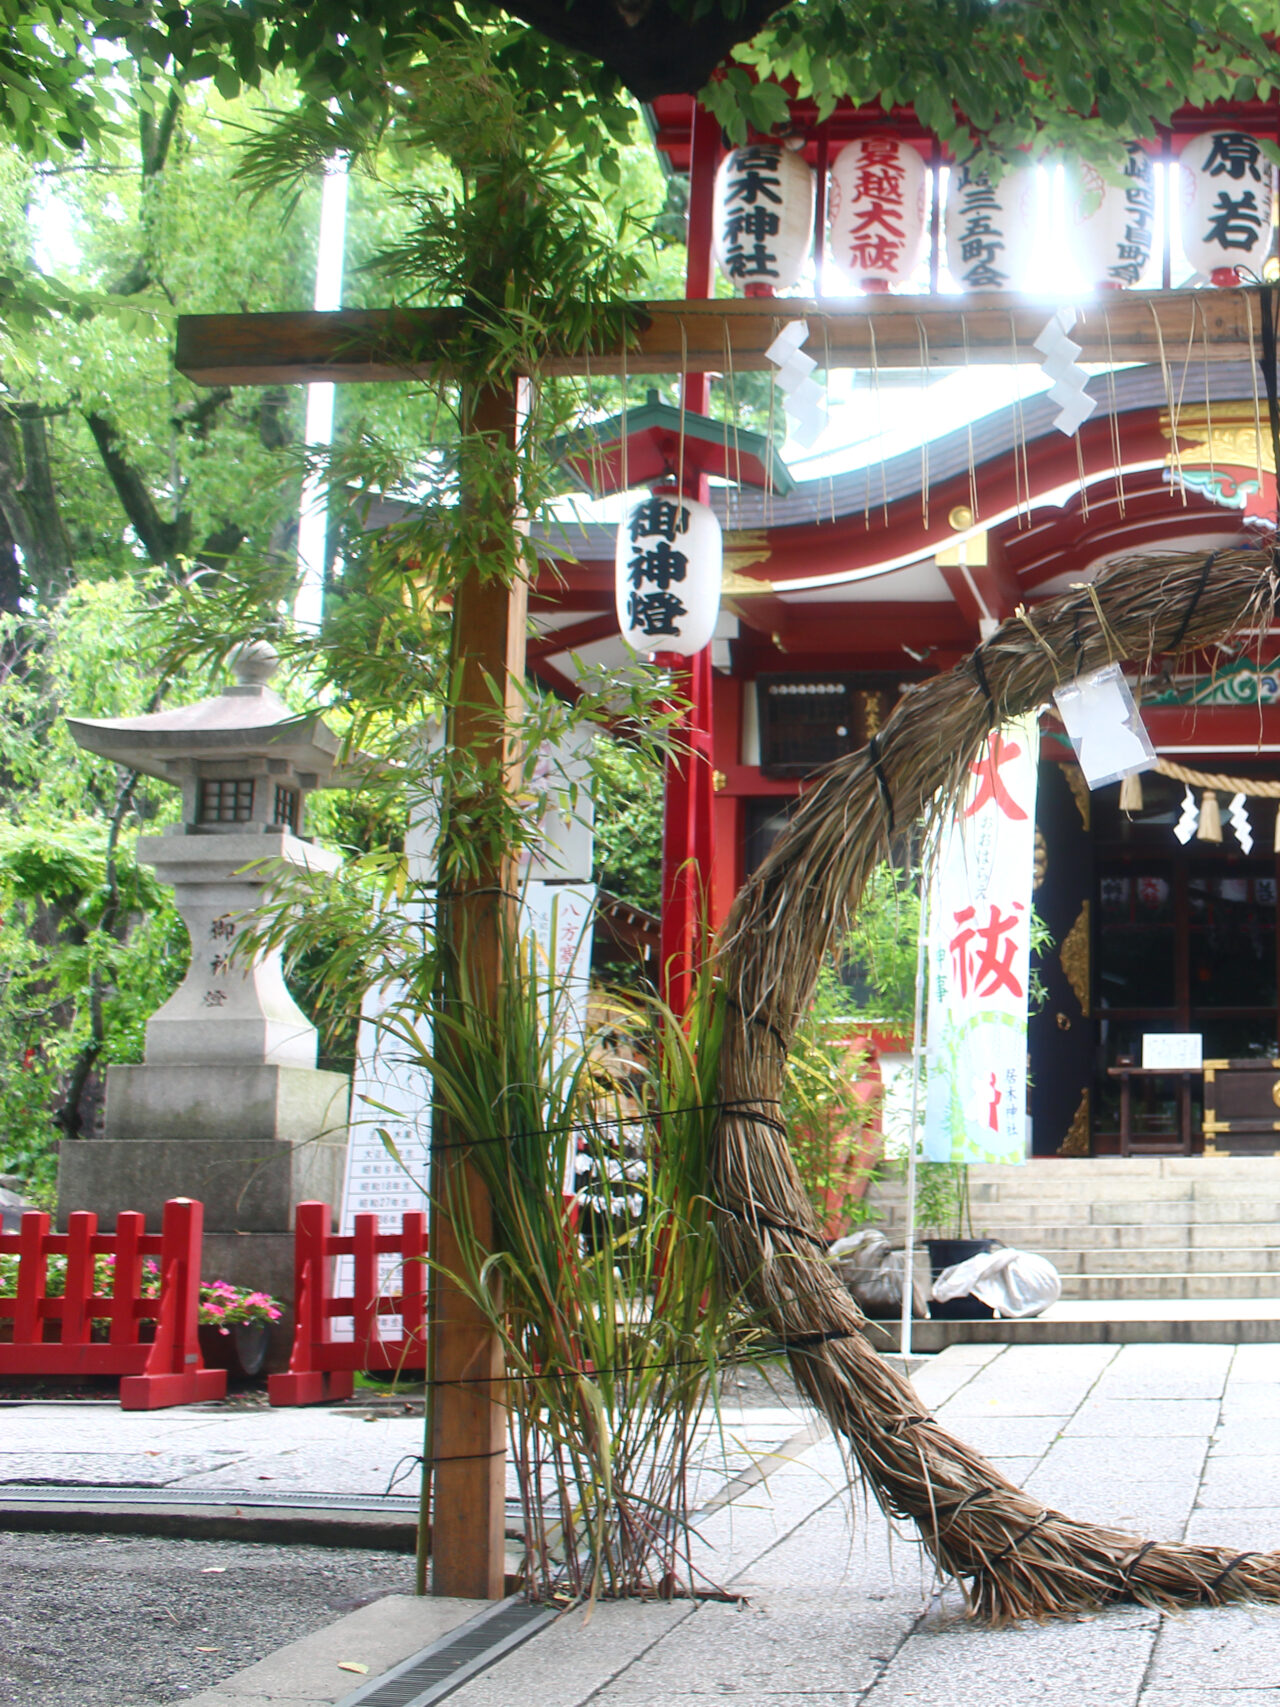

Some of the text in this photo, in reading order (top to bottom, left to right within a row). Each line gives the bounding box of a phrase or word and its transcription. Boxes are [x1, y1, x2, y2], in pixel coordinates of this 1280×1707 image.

[724, 146, 782, 278] 居木神社
[849, 140, 906, 273] 夏越大祓
[1107, 140, 1156, 285] 崎四丁目町会
[1202, 132, 1262, 253] 原若
[626, 498, 692, 637] 御神燈
